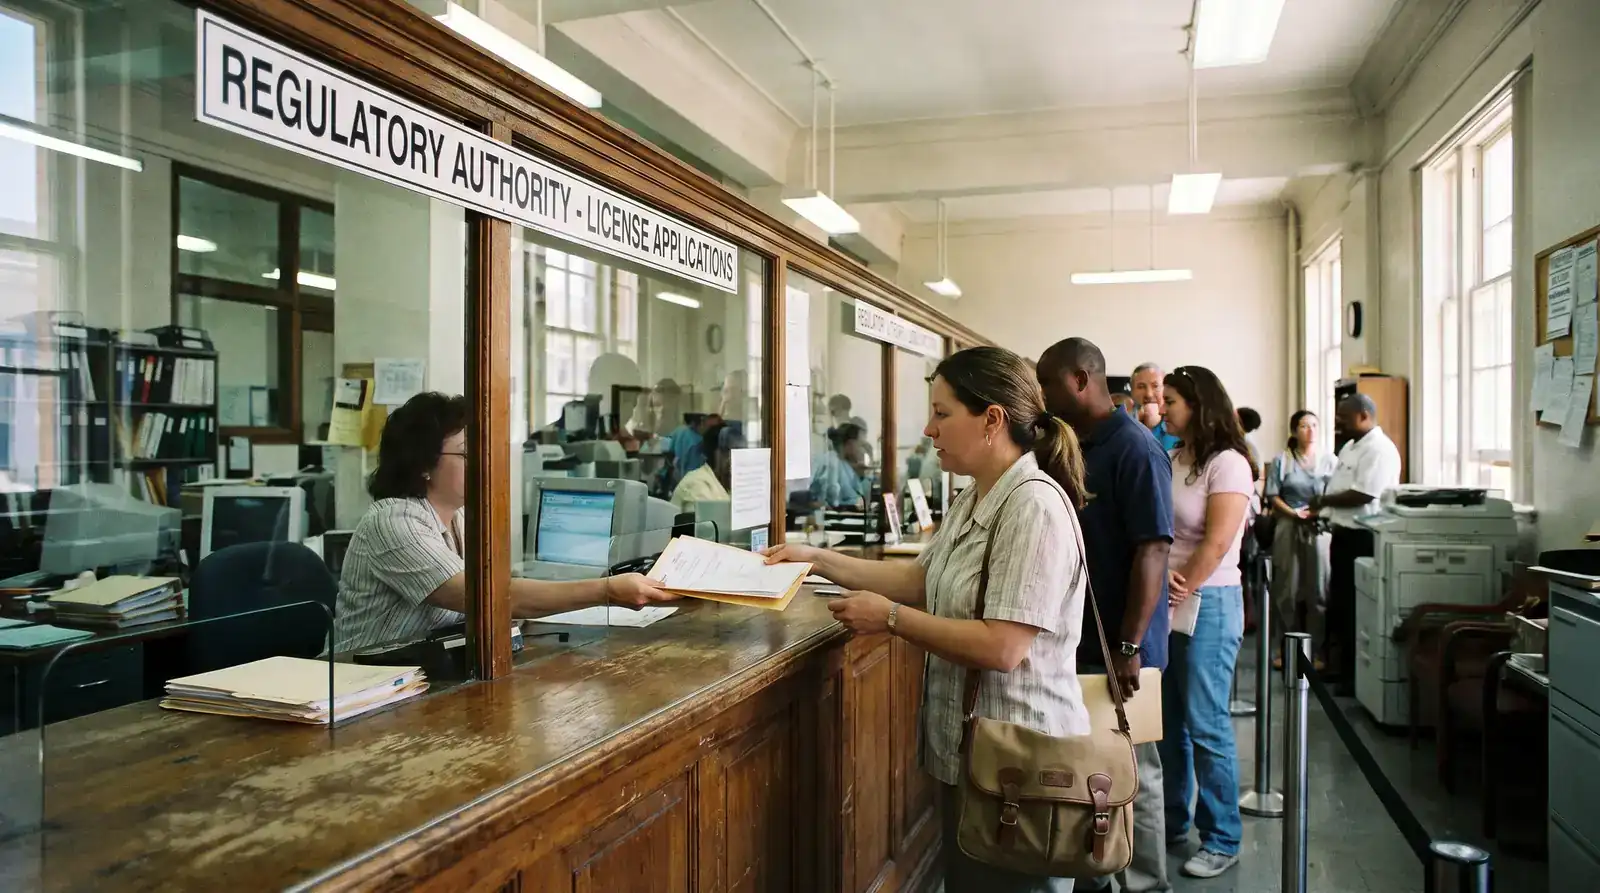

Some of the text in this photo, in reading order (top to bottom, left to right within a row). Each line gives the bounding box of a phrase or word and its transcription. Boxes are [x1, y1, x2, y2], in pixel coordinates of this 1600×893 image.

[222, 44, 445, 178] REGULATORY
[452, 142, 571, 223] AUTHORITY
[587, 195, 649, 252] LICENSE
[653, 224, 733, 282] APPLICATIONS
